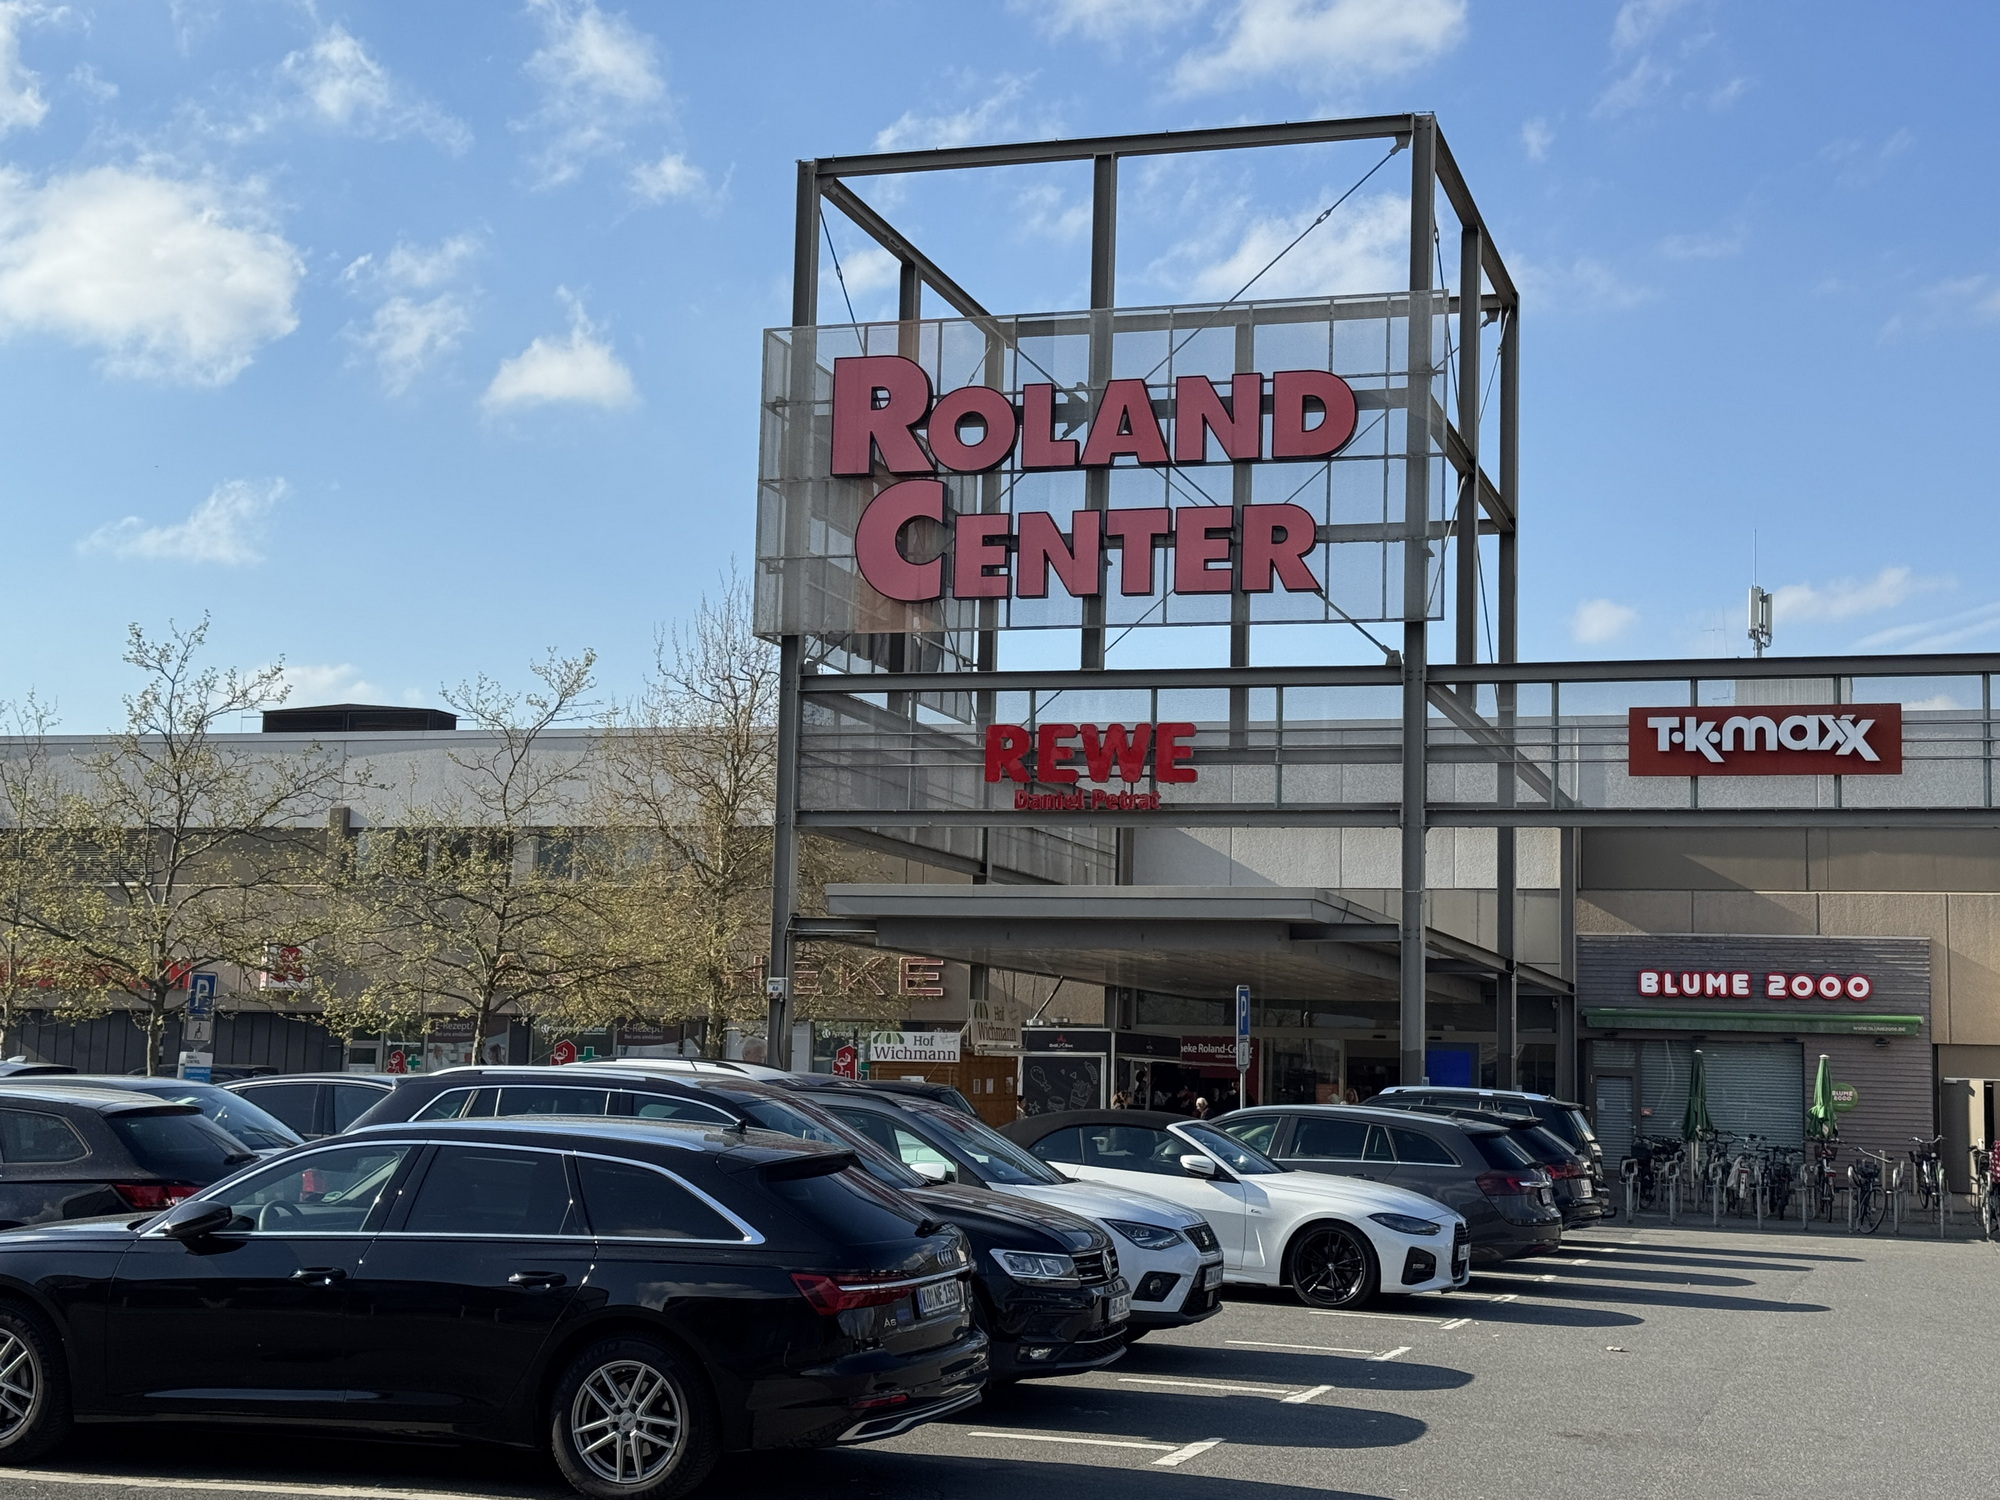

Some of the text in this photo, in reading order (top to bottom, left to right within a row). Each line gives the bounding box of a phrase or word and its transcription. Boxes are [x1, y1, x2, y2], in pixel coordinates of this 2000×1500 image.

[831, 355, 1358, 477] ROLAND
[855, 479, 1322, 602] CENTER
[985, 723, 1198, 784] REWE
[1014, 789, 1161, 810] Daniel Petrat
[195, 979, 209, 1010] P
[1639, 970, 1872, 1000] BLUME 2000
[994, 1006, 1005, 1022] Hof
[1241, 996, 1246, 1030] P
[913, 1035, 935, 1047] Hof
[978, 1021, 1017, 1042] Wichmann
[874, 1046, 957, 1061] Wichmann
[884, 1318, 897, 1328] A6
